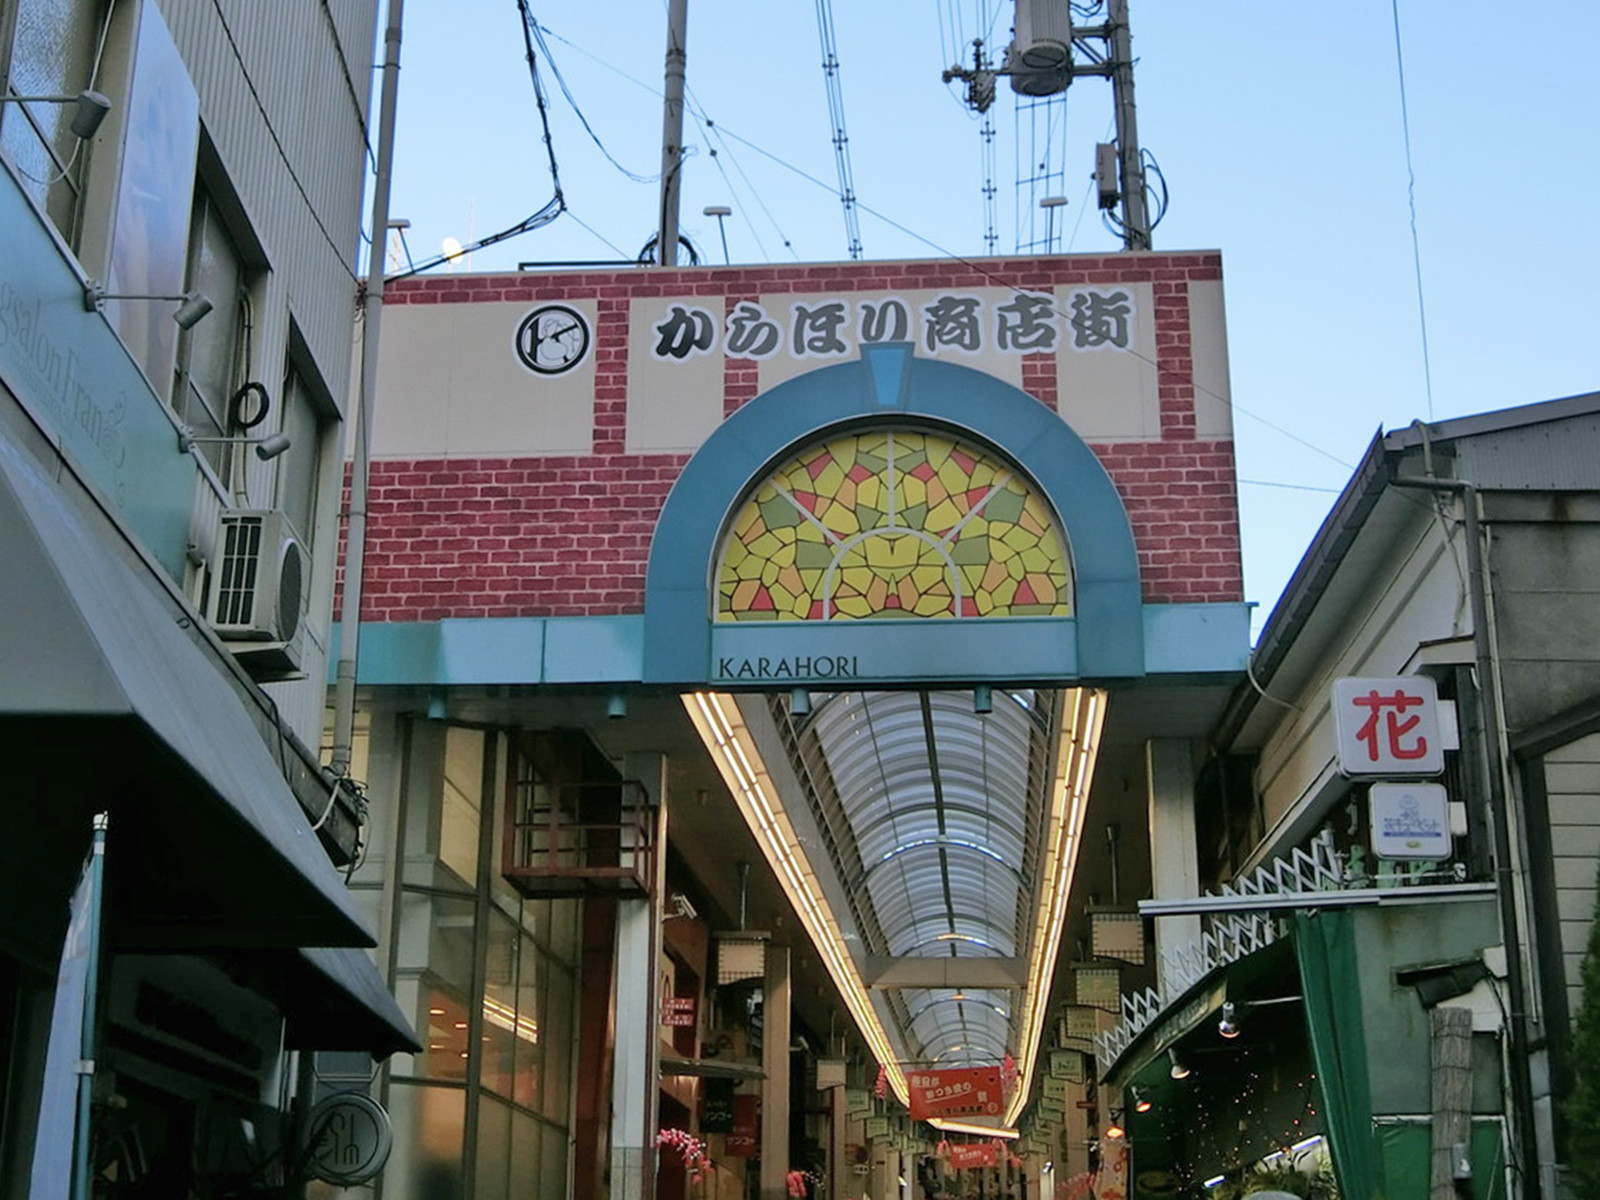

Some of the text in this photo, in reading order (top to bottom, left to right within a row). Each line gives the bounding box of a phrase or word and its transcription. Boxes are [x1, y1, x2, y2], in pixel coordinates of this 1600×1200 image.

[655, 287, 1133, 360] からほり商店街
[719, 656, 858, 680] KARAHORI
[1352, 689, 1427, 762] 花
